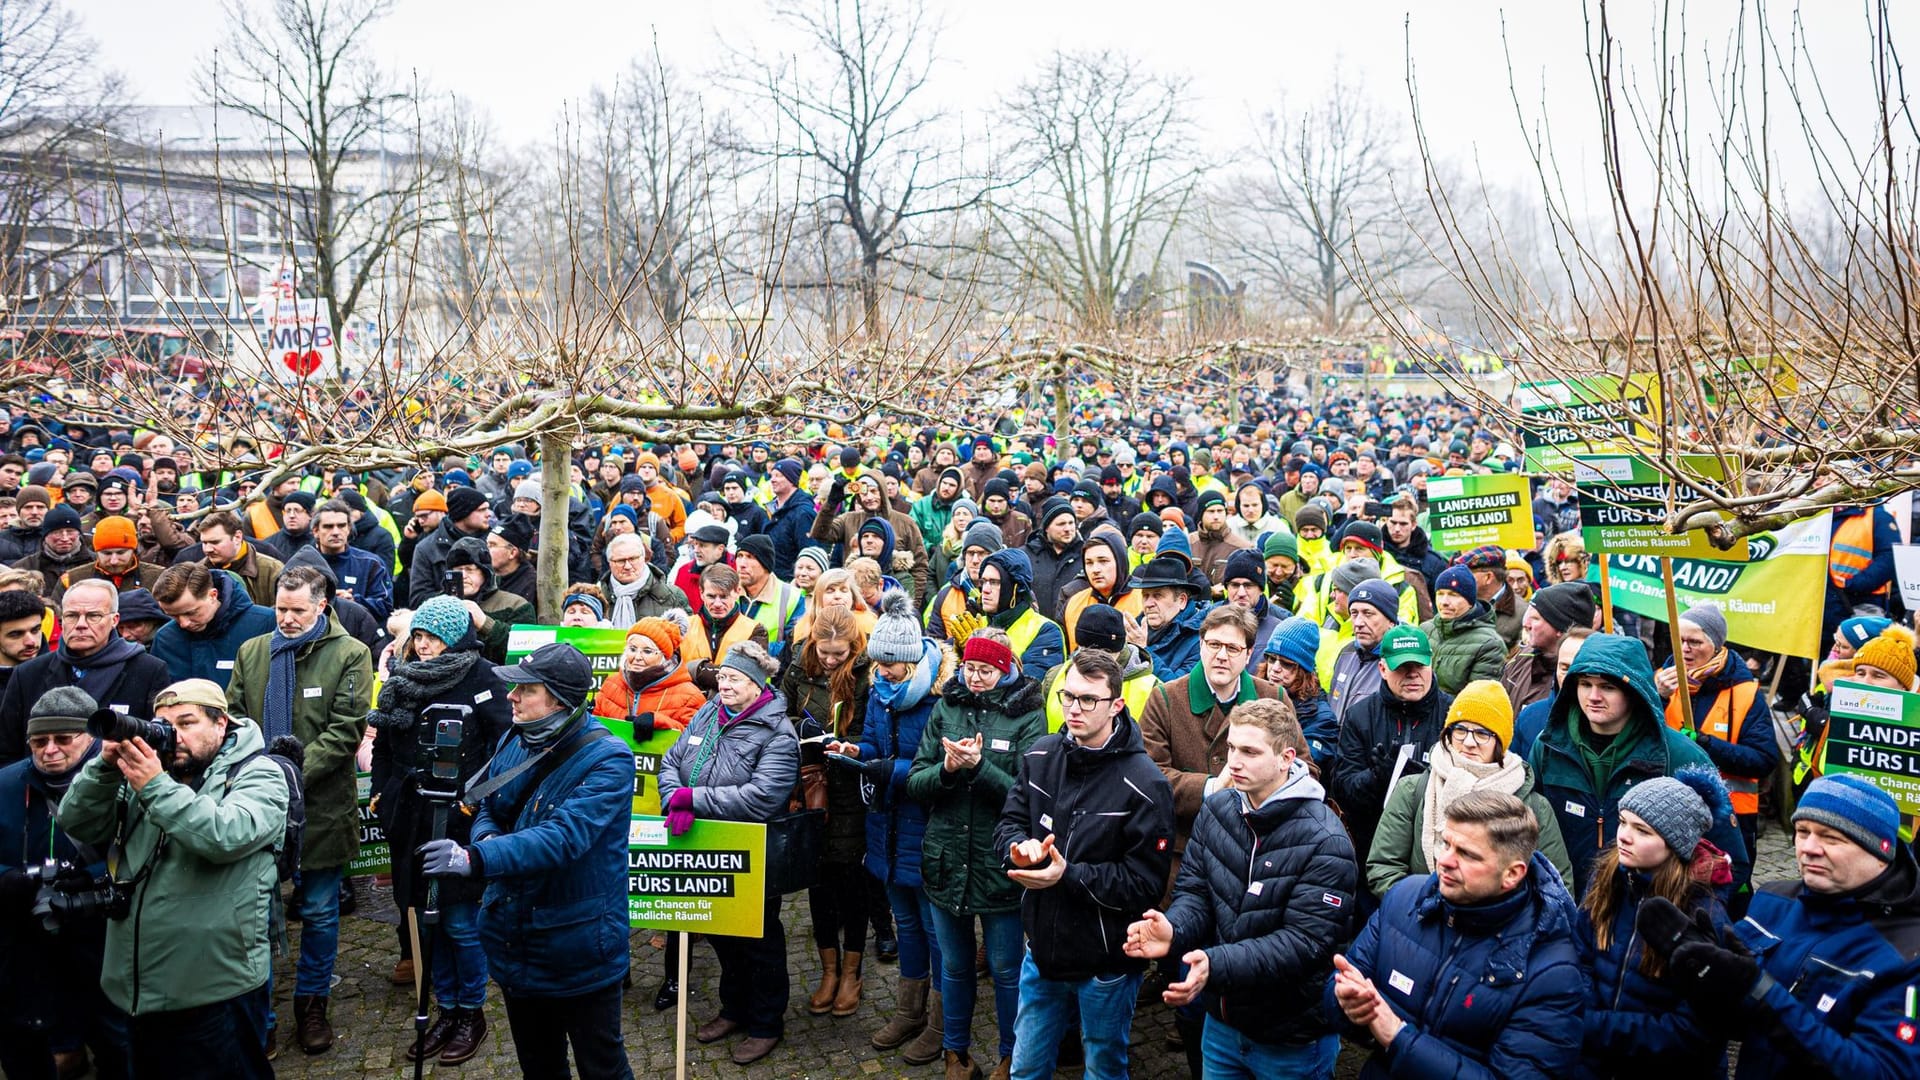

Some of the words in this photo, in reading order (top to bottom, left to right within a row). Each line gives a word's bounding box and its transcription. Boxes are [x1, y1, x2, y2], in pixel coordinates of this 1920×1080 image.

[268, 326, 332, 349] MOB
[1438, 494, 1516, 512] LANDFRAUEN
[1440, 514, 1470, 528] FÜRS
[1471, 510, 1508, 525] LAND!
[1598, 507, 1642, 523] FÜRS
[1601, 529, 1626, 538] Faire
[1603, 539, 1648, 547] ländliche
[1651, 538, 1691, 547] Räume!
[1608, 576, 1628, 589] aire
[1729, 599, 1776, 614] Räume!
[1393, 641, 1420, 649] Bauern
[1839, 699, 1859, 708] Land
[1866, 703, 1896, 713] Frauen
[1847, 746, 1903, 771] FÜRS
[628, 853, 743, 869] LANDFRAUEN
[629, 874, 671, 892] FÜRS
[675, 877, 728, 893] LAND!
[629, 900, 652, 908] Faire
[655, 899, 696, 909] Chancen
[697, 899, 712, 908] für
[629, 911, 673, 920] ländliche
[675, 911, 712, 921] Räume!
